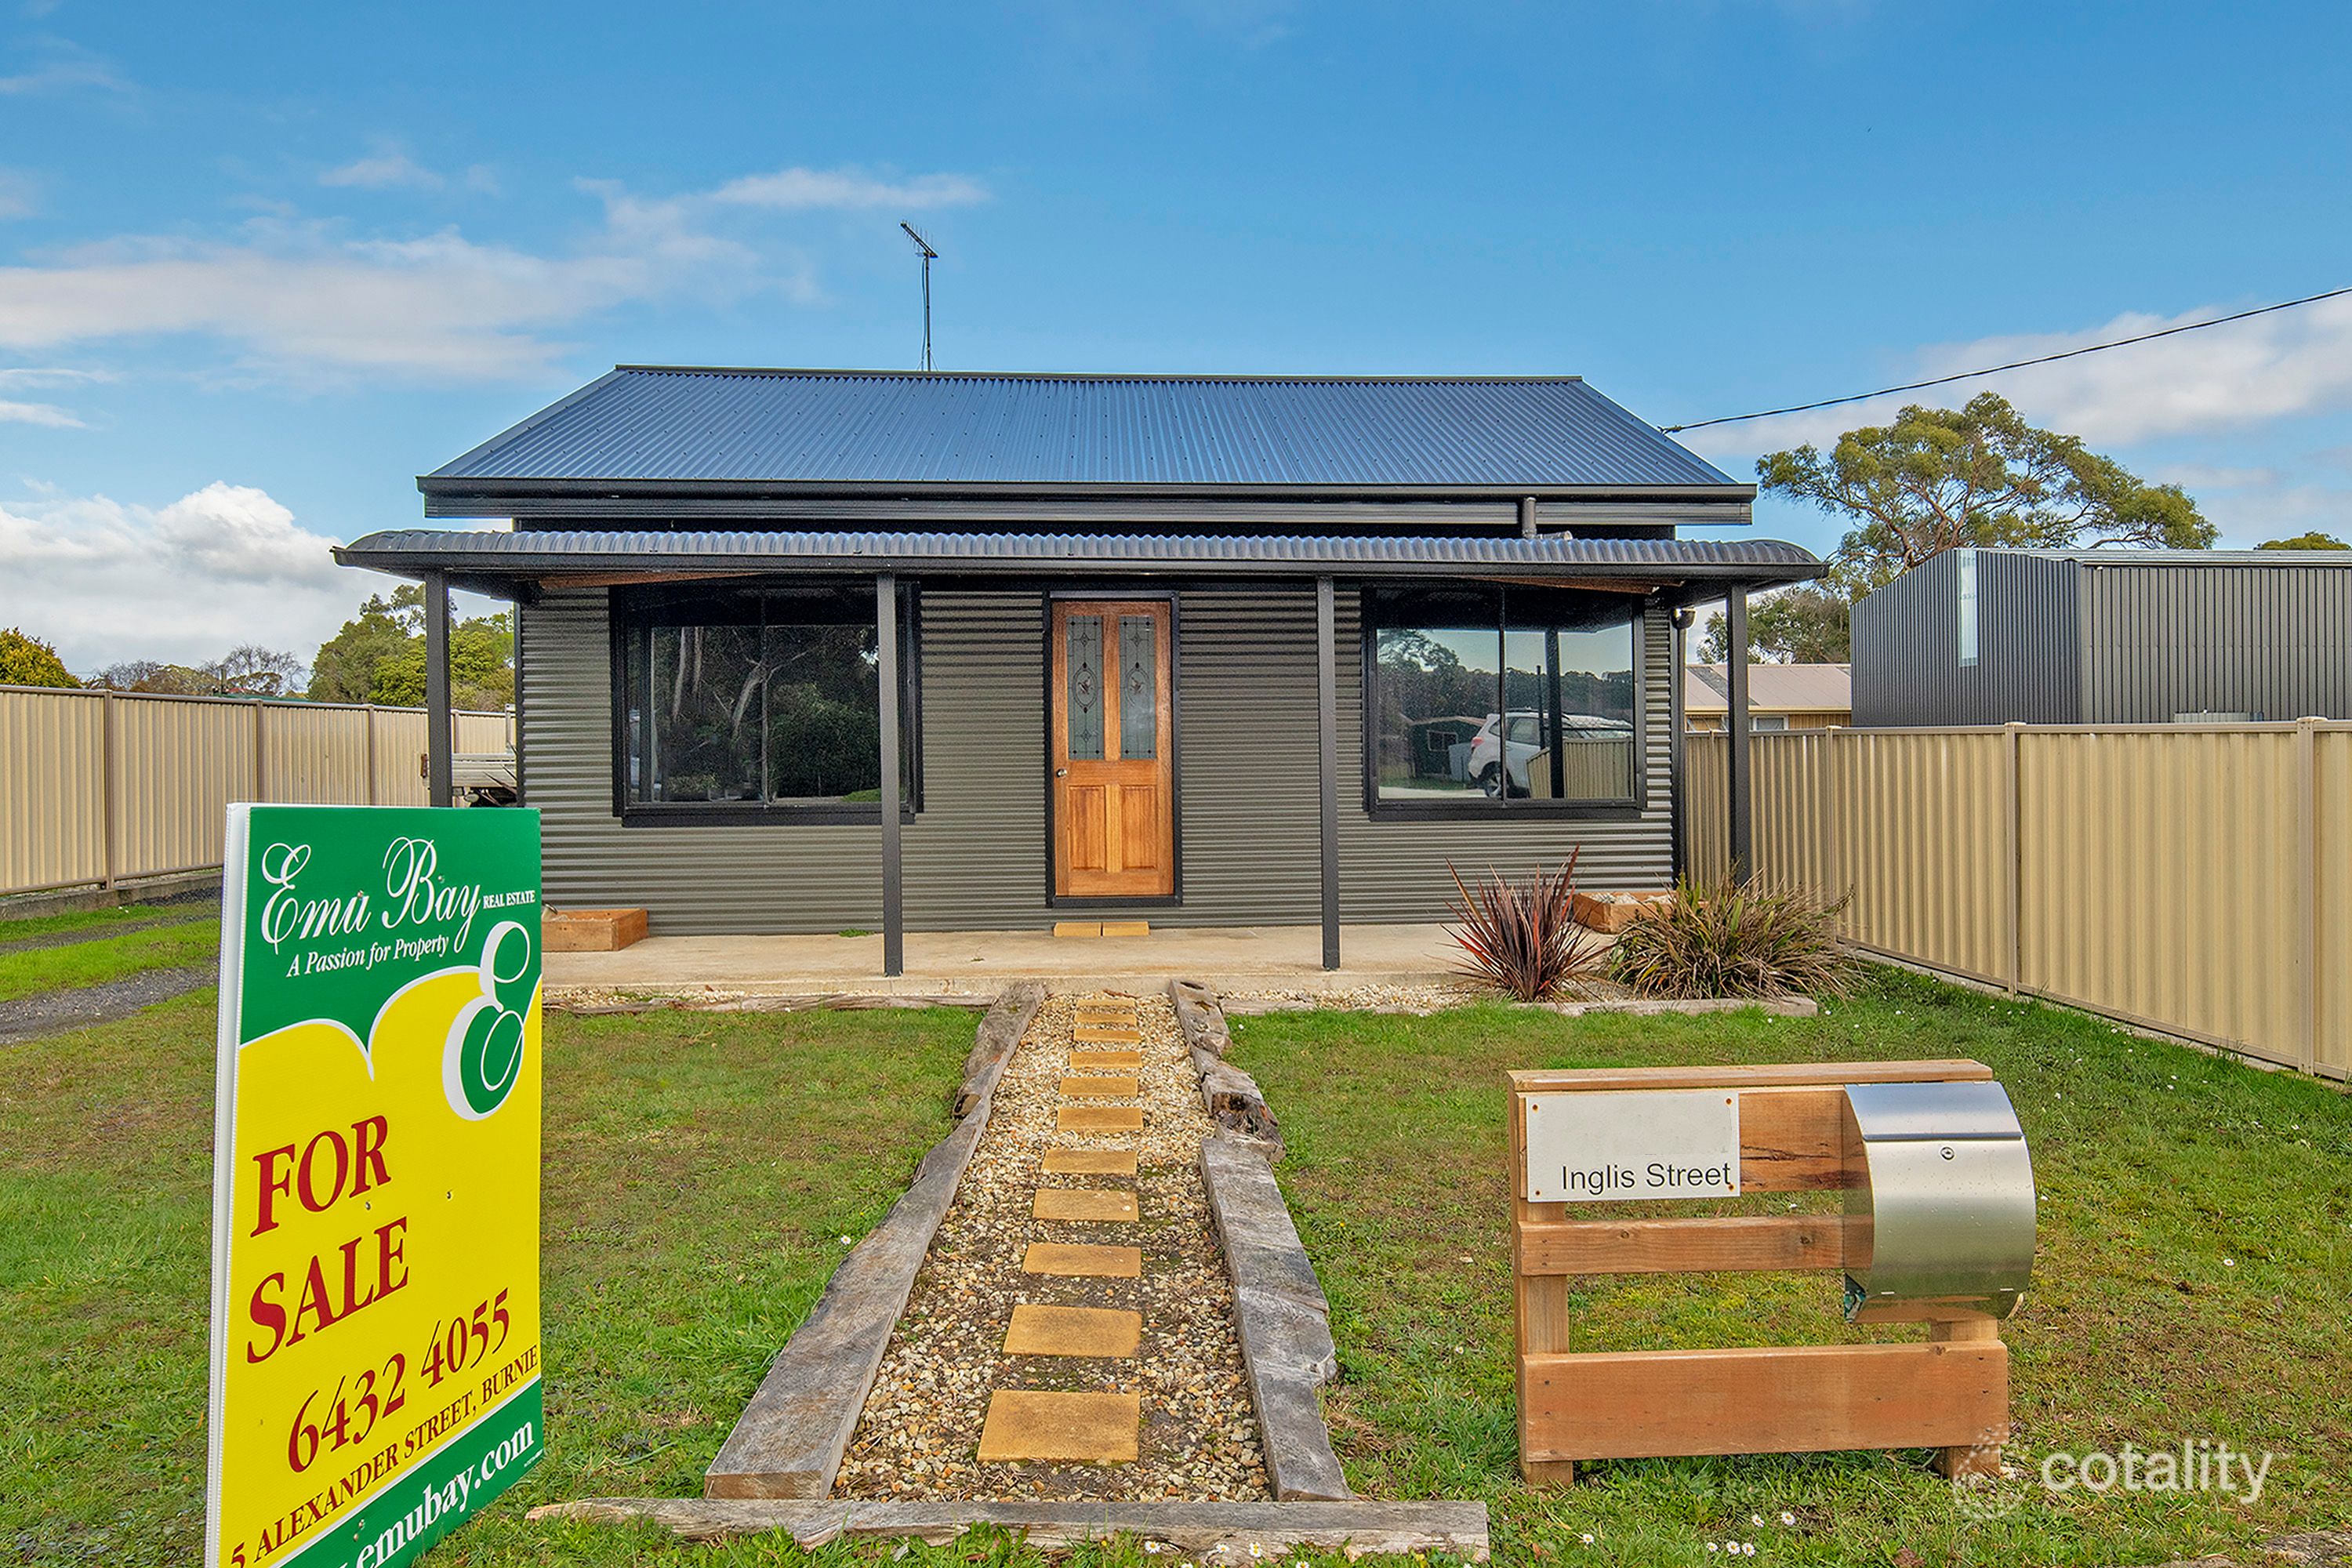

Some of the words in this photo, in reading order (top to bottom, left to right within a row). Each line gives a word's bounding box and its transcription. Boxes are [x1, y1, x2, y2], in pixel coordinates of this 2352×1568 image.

[261, 843, 372, 955] Emu
[381, 837, 481, 953] Bay
[483, 894, 505, 909] REAL
[506, 890, 535, 906] ESTATE
[286, 953, 301, 978] A
[306, 947, 365, 975] Passion
[365, 940, 392, 971] for
[393, 934, 450, 964] Property
[250, 1115, 391, 1238] FOR
[1562, 1163, 1635, 1195] Inglis
[1646, 1162, 1731, 1187] Street
[247, 1216, 409, 1364] SALE
[287, 1352, 406, 1473] 6432
[420, 1287, 510, 1389] 4055
[230, 1541, 245, 1568] 5
[254, 1443, 398, 1563] ALEXANDER
[404, 1390, 477, 1458] STREET,
[481, 1345, 539, 1406] BURNIE
